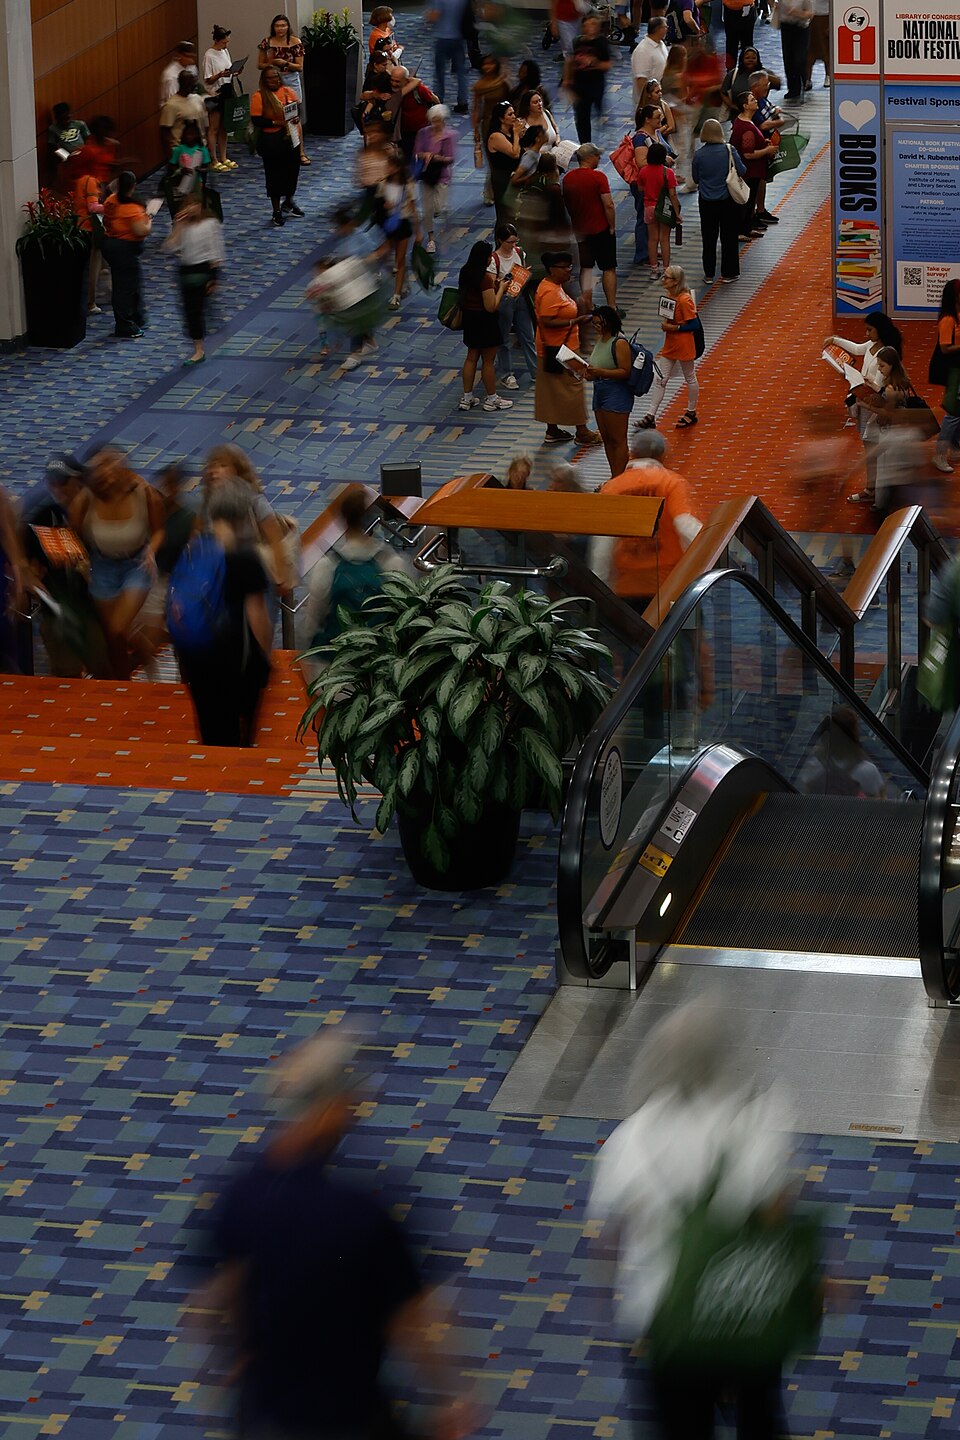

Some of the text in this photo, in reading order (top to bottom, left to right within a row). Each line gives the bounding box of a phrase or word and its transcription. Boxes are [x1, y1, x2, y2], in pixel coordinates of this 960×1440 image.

[903, 20, 958, 39] NATIONAL
[888, 40, 920, 59] BOOK
[888, 97, 927, 105] Festival
[839, 134, 877, 212] BOOKS
